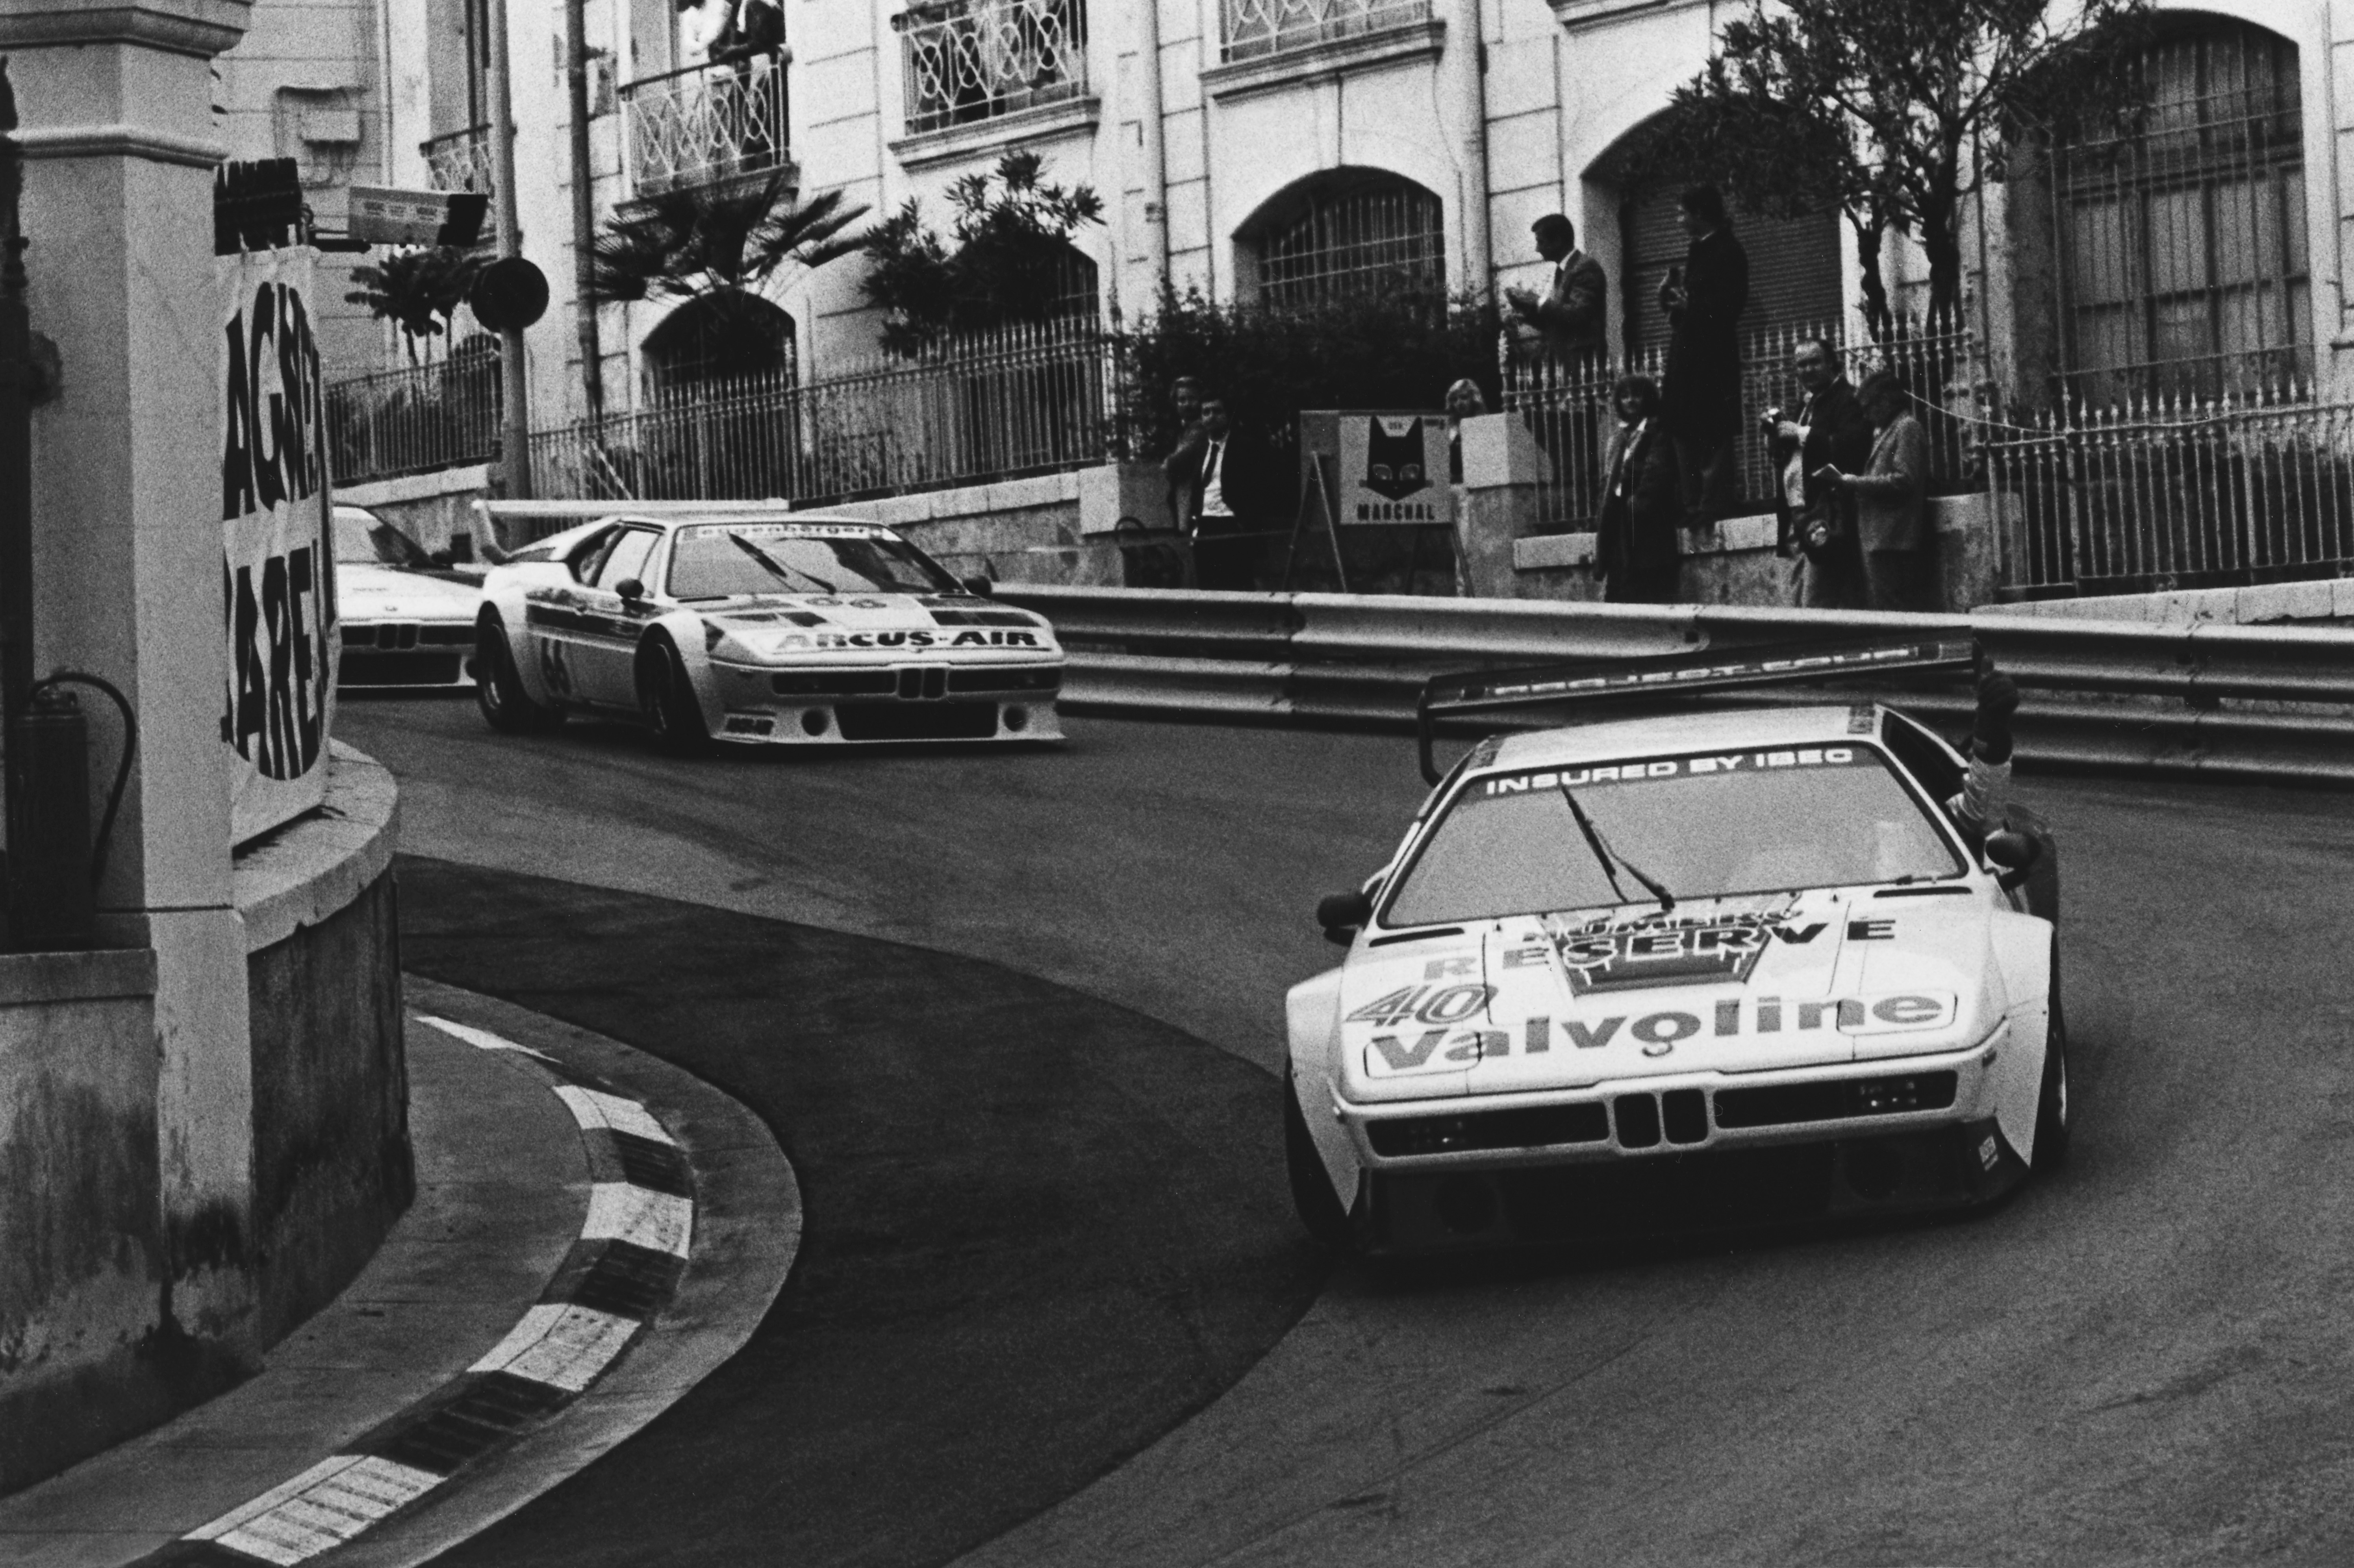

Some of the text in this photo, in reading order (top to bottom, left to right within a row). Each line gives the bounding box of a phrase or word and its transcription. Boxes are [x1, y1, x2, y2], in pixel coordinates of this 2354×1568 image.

[1358, 504, 1435, 520] MARCHAL
[777, 631, 1038, 649] ARCUS-AIR
[1486, 761, 1678, 794] INSURED
[1689, 755, 1743, 773] BY
[1424, 920, 1896, 980] RESERVE
[1344, 984, 1499, 1027] 40
